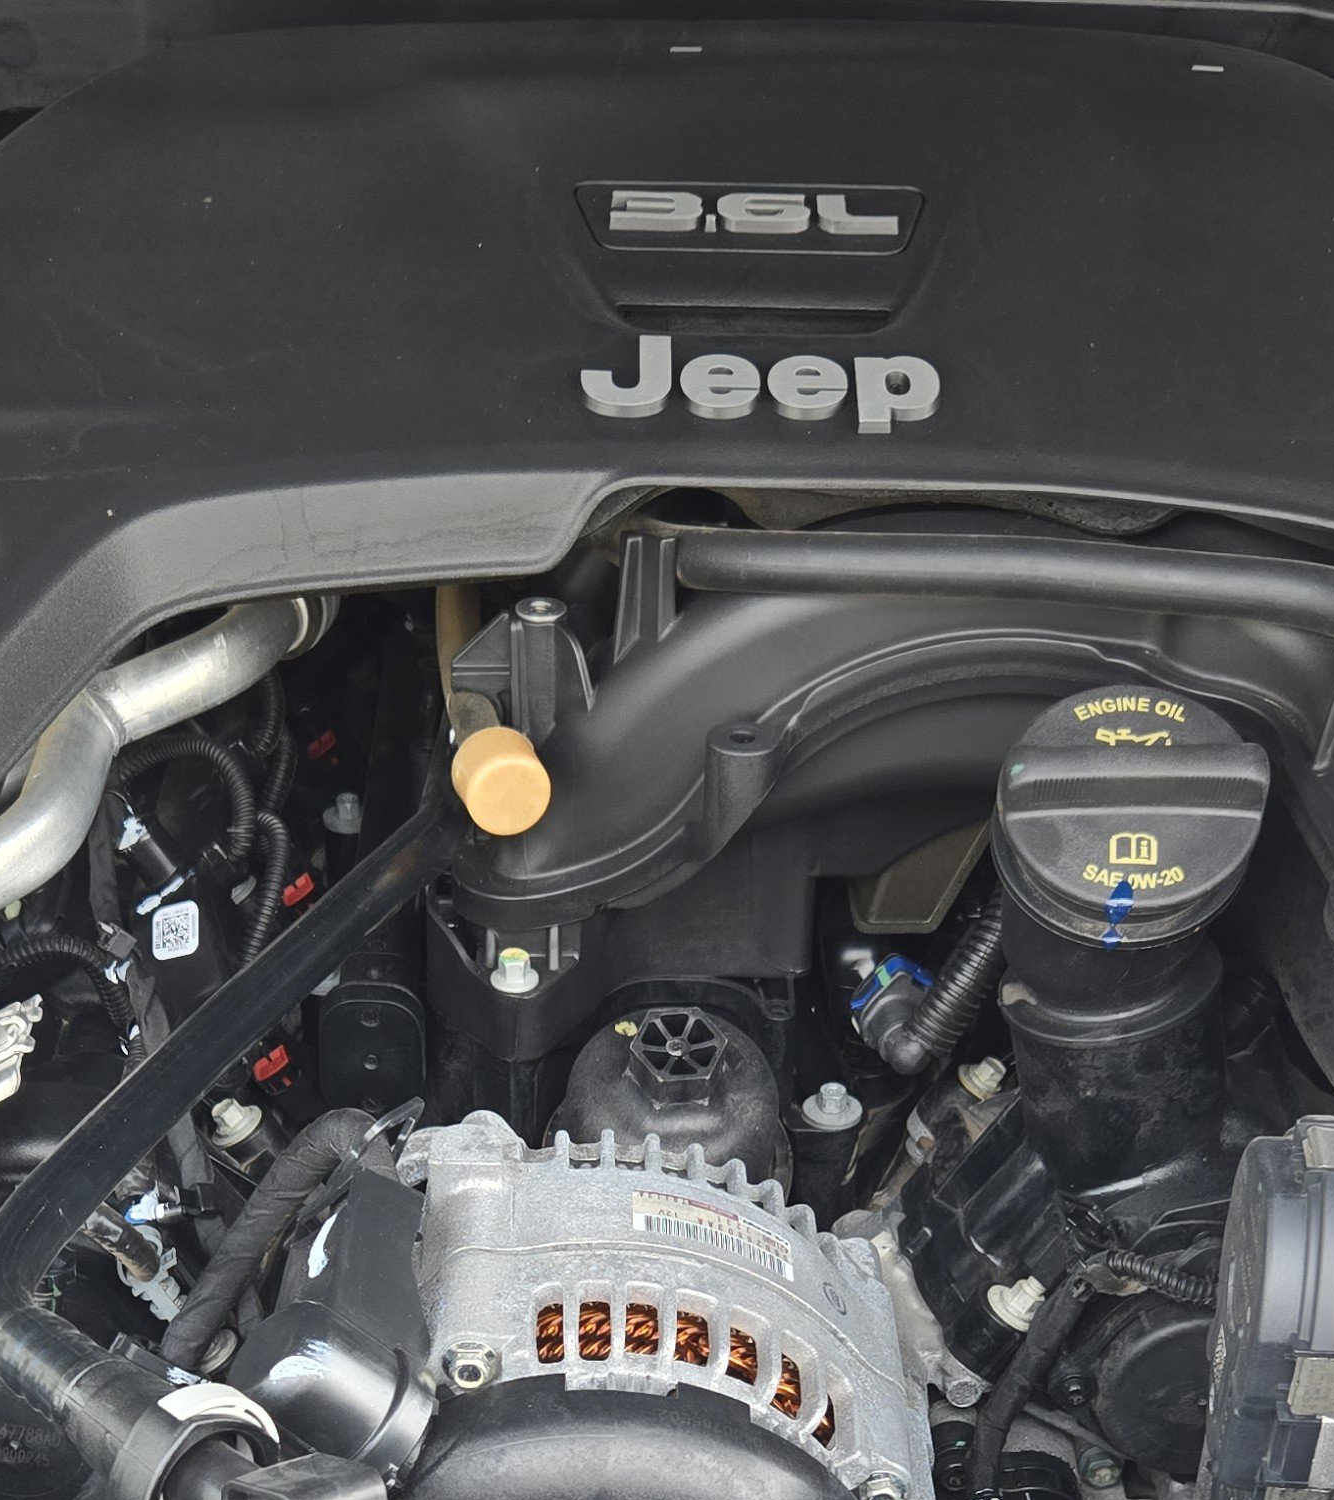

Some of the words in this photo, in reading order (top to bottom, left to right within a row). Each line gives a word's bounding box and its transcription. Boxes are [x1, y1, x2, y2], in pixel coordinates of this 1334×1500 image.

[609, 190, 899, 235] 3.6L
[580, 334, 940, 434] Jeep
[1073, 696, 1151, 722] ENGINE
[1154, 700, 1186, 723] OIL
[1082, 863, 1123, 889] SAE
[1127, 866, 1185, 890] 0W-20
